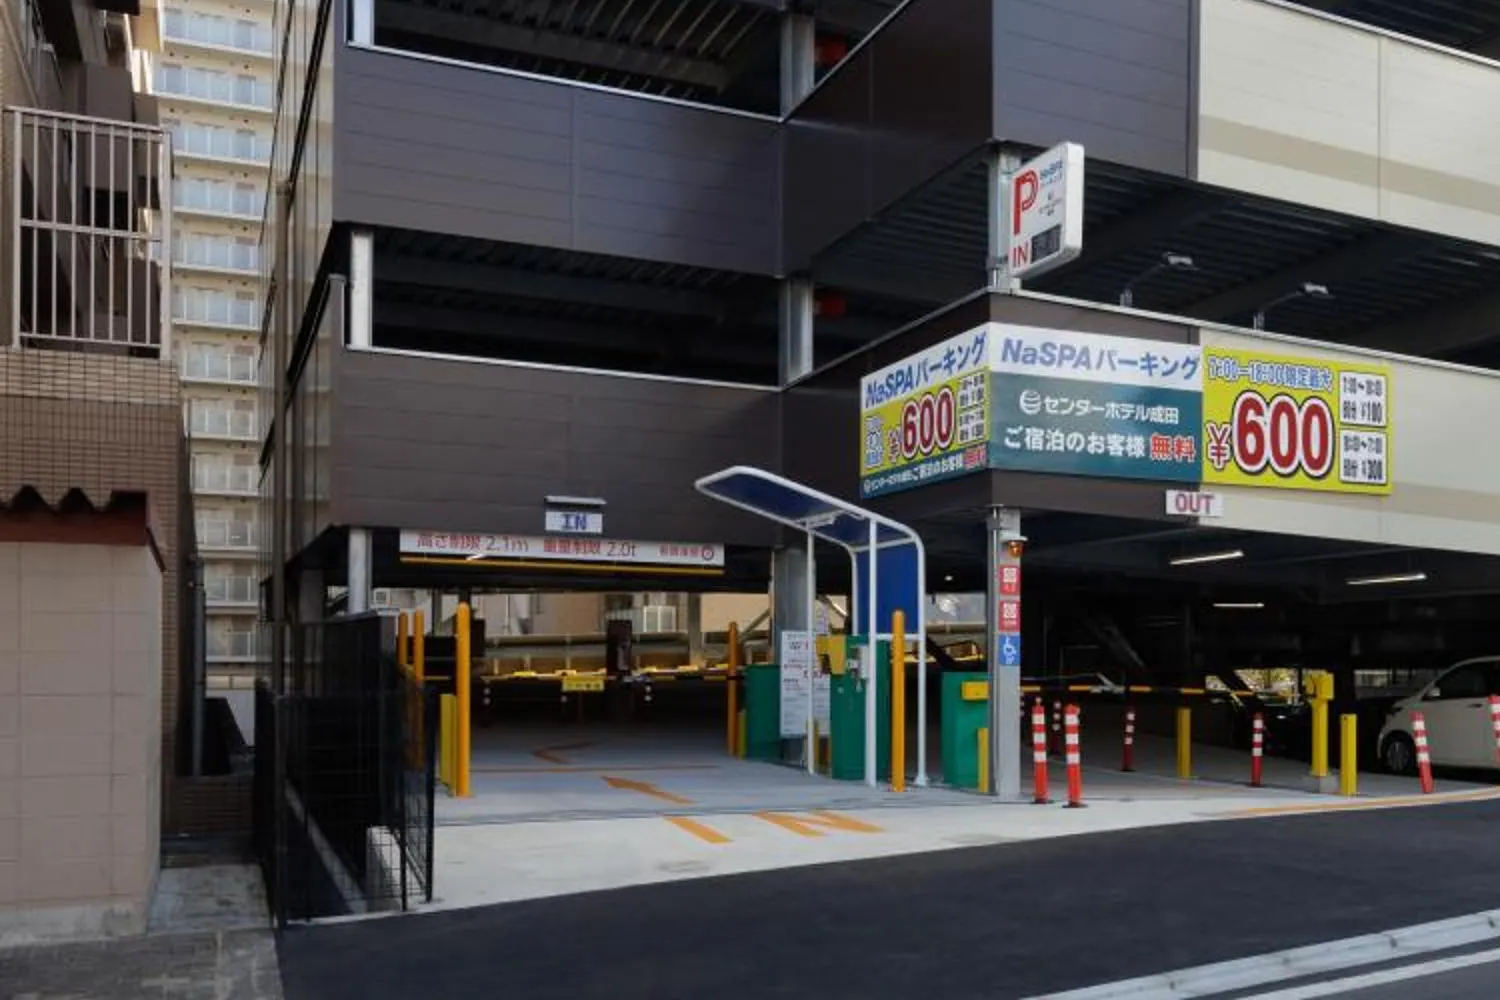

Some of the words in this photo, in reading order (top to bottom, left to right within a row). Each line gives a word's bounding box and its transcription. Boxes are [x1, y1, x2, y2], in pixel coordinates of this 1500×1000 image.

[1013, 169, 1039, 238] P
[1012, 242, 1029, 269] IN
[866, 332, 987, 409] NaSPAパーキング
[1001, 337, 1200, 380] NaSPAパーキング
[1043, 395, 1180, 425] センターホテル成田
[1003, 425, 1147, 460] ご宿泊のお客様
[1150, 431, 1196, 464] 無料
[1205, 390, 1336, 479] ¥600
[1175, 493, 1215, 515] OUT
[562, 513, 587, 531] IN
[485, 535, 529, 553] 2.1m
